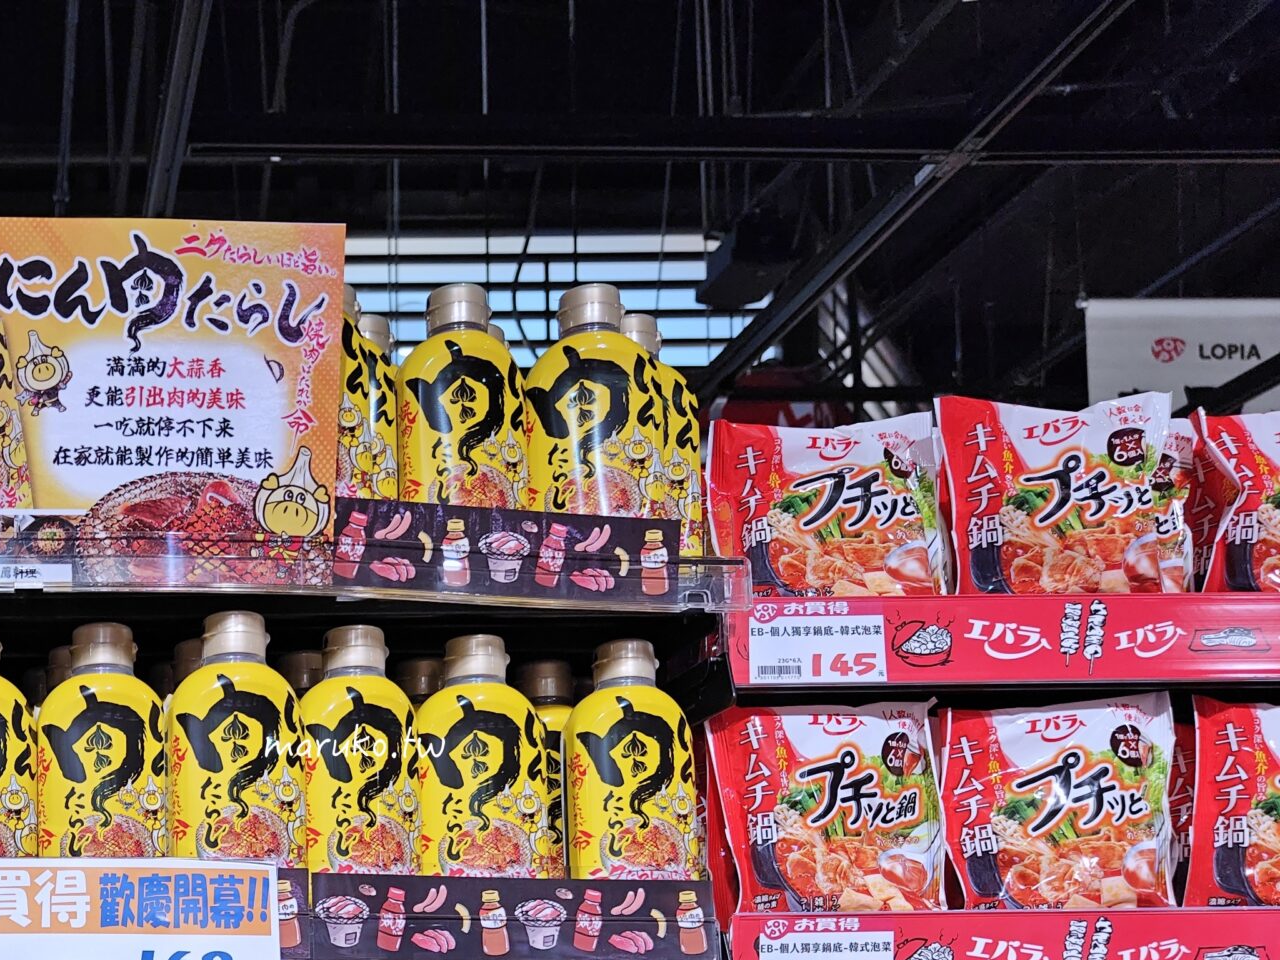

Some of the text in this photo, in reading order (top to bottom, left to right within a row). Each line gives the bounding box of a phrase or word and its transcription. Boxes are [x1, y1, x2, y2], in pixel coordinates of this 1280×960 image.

[1199, 343, 1262, 360] LOPIA
[84, 386, 247, 410] 更能引出肉的美味
[93, 417, 235, 439] 一吃就停不下来
[1022, 415, 1090, 446] エバラ
[736, 446, 772, 553] キムチ鍋
[965, 422, 1004, 549] キムチ鍋
[783, 602, 850, 615] お買得
[750, 625, 883, 637] EB-個人獨享鍋底-韓式泡菜
[963, 618, 1053, 660] エバラ
[812, 653, 877, 677] 145
[740, 721, 777, 845] キムチ鍋
[798, 750, 918, 826] プチッと鍋
[949, 736, 998, 858] キムチ鍋
[1213, 722, 1250, 848] キムチ鍋
[99, 873, 269, 930] 歡慶開幕!!
[794, 918, 860, 931] お買得
[760, 941, 892, 954] EB-個人獨享鍋底-韓式泡菜
